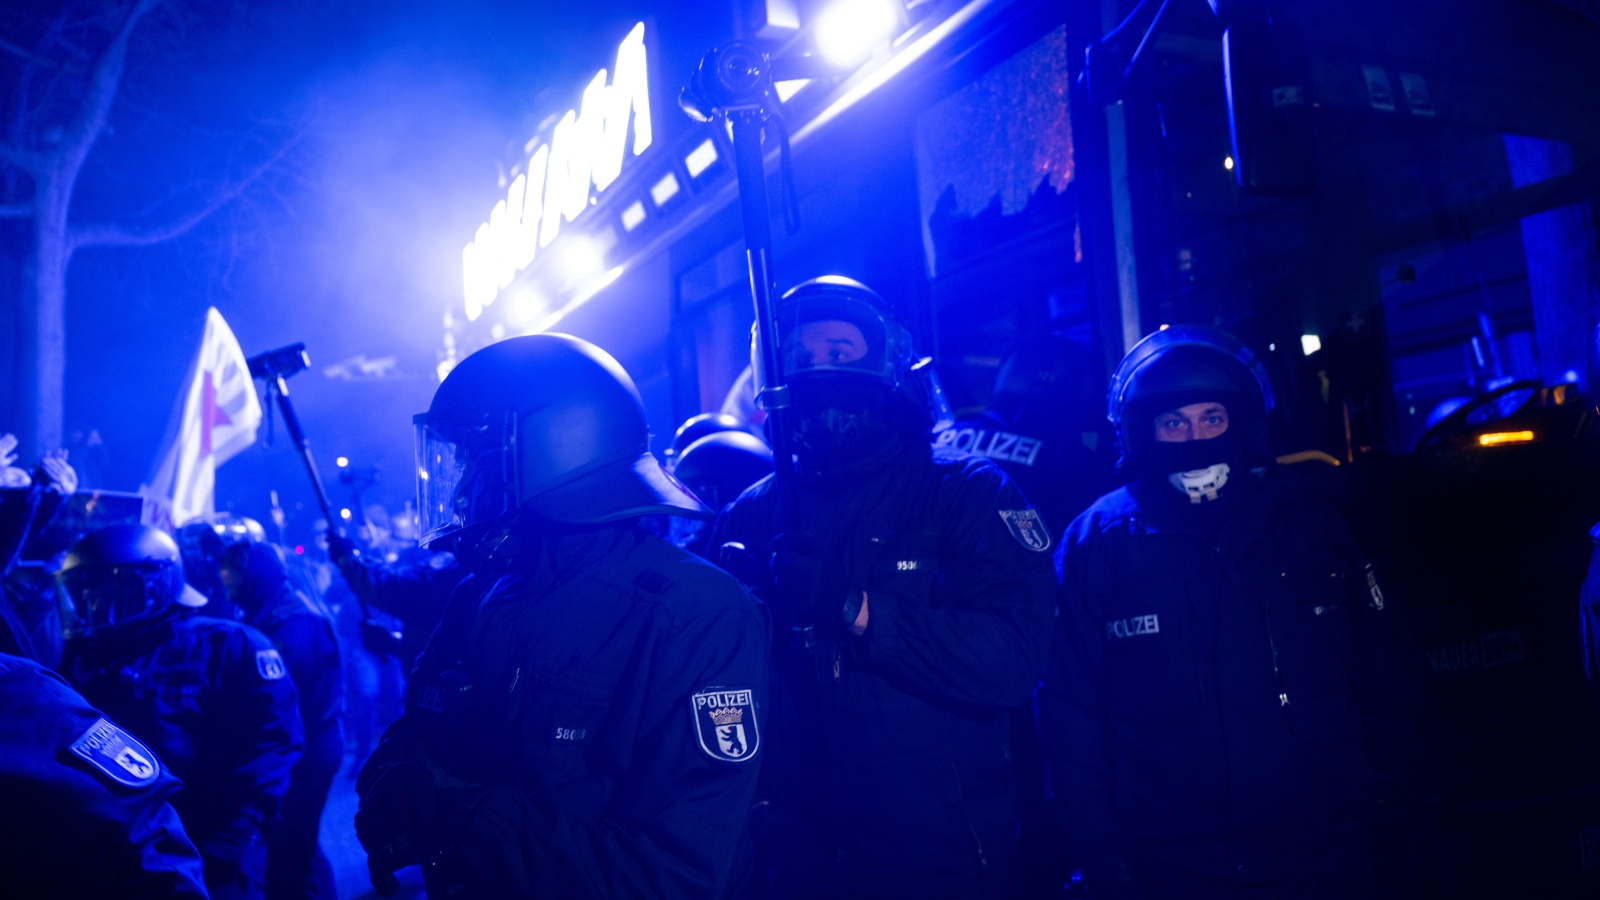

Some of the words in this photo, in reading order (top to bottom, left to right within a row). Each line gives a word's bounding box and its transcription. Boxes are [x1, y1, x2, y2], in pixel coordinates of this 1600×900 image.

[936, 427, 1042, 467] POLIZEI
[1105, 613, 1160, 640] POLIZEI
[696, 692, 749, 711] POLIZEI
